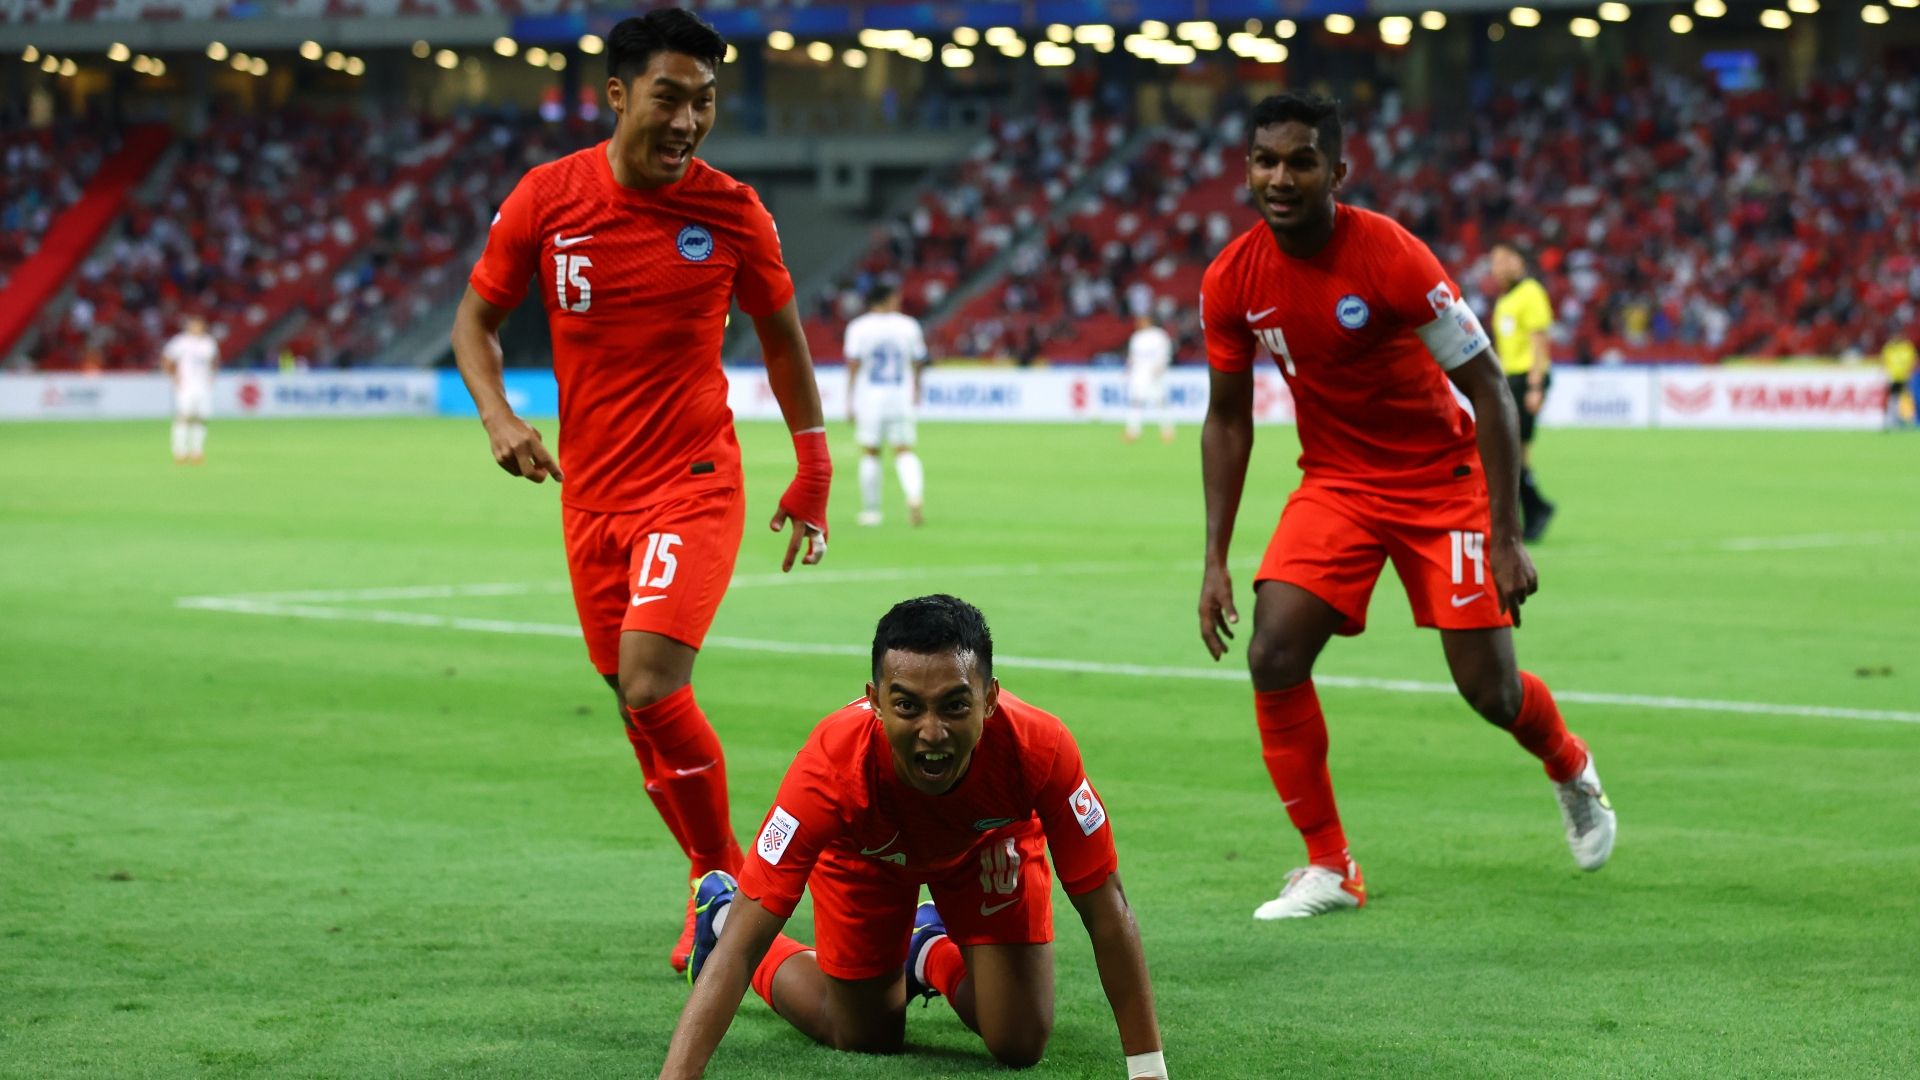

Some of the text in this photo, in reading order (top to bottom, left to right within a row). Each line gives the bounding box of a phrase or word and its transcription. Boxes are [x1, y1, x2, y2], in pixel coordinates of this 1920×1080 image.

[553, 254, 593, 313] 15
[869, 342, 904, 386] 21
[638, 532, 684, 589] 15
[1448, 530, 1485, 585] 14
[980, 836, 1021, 894] 10
